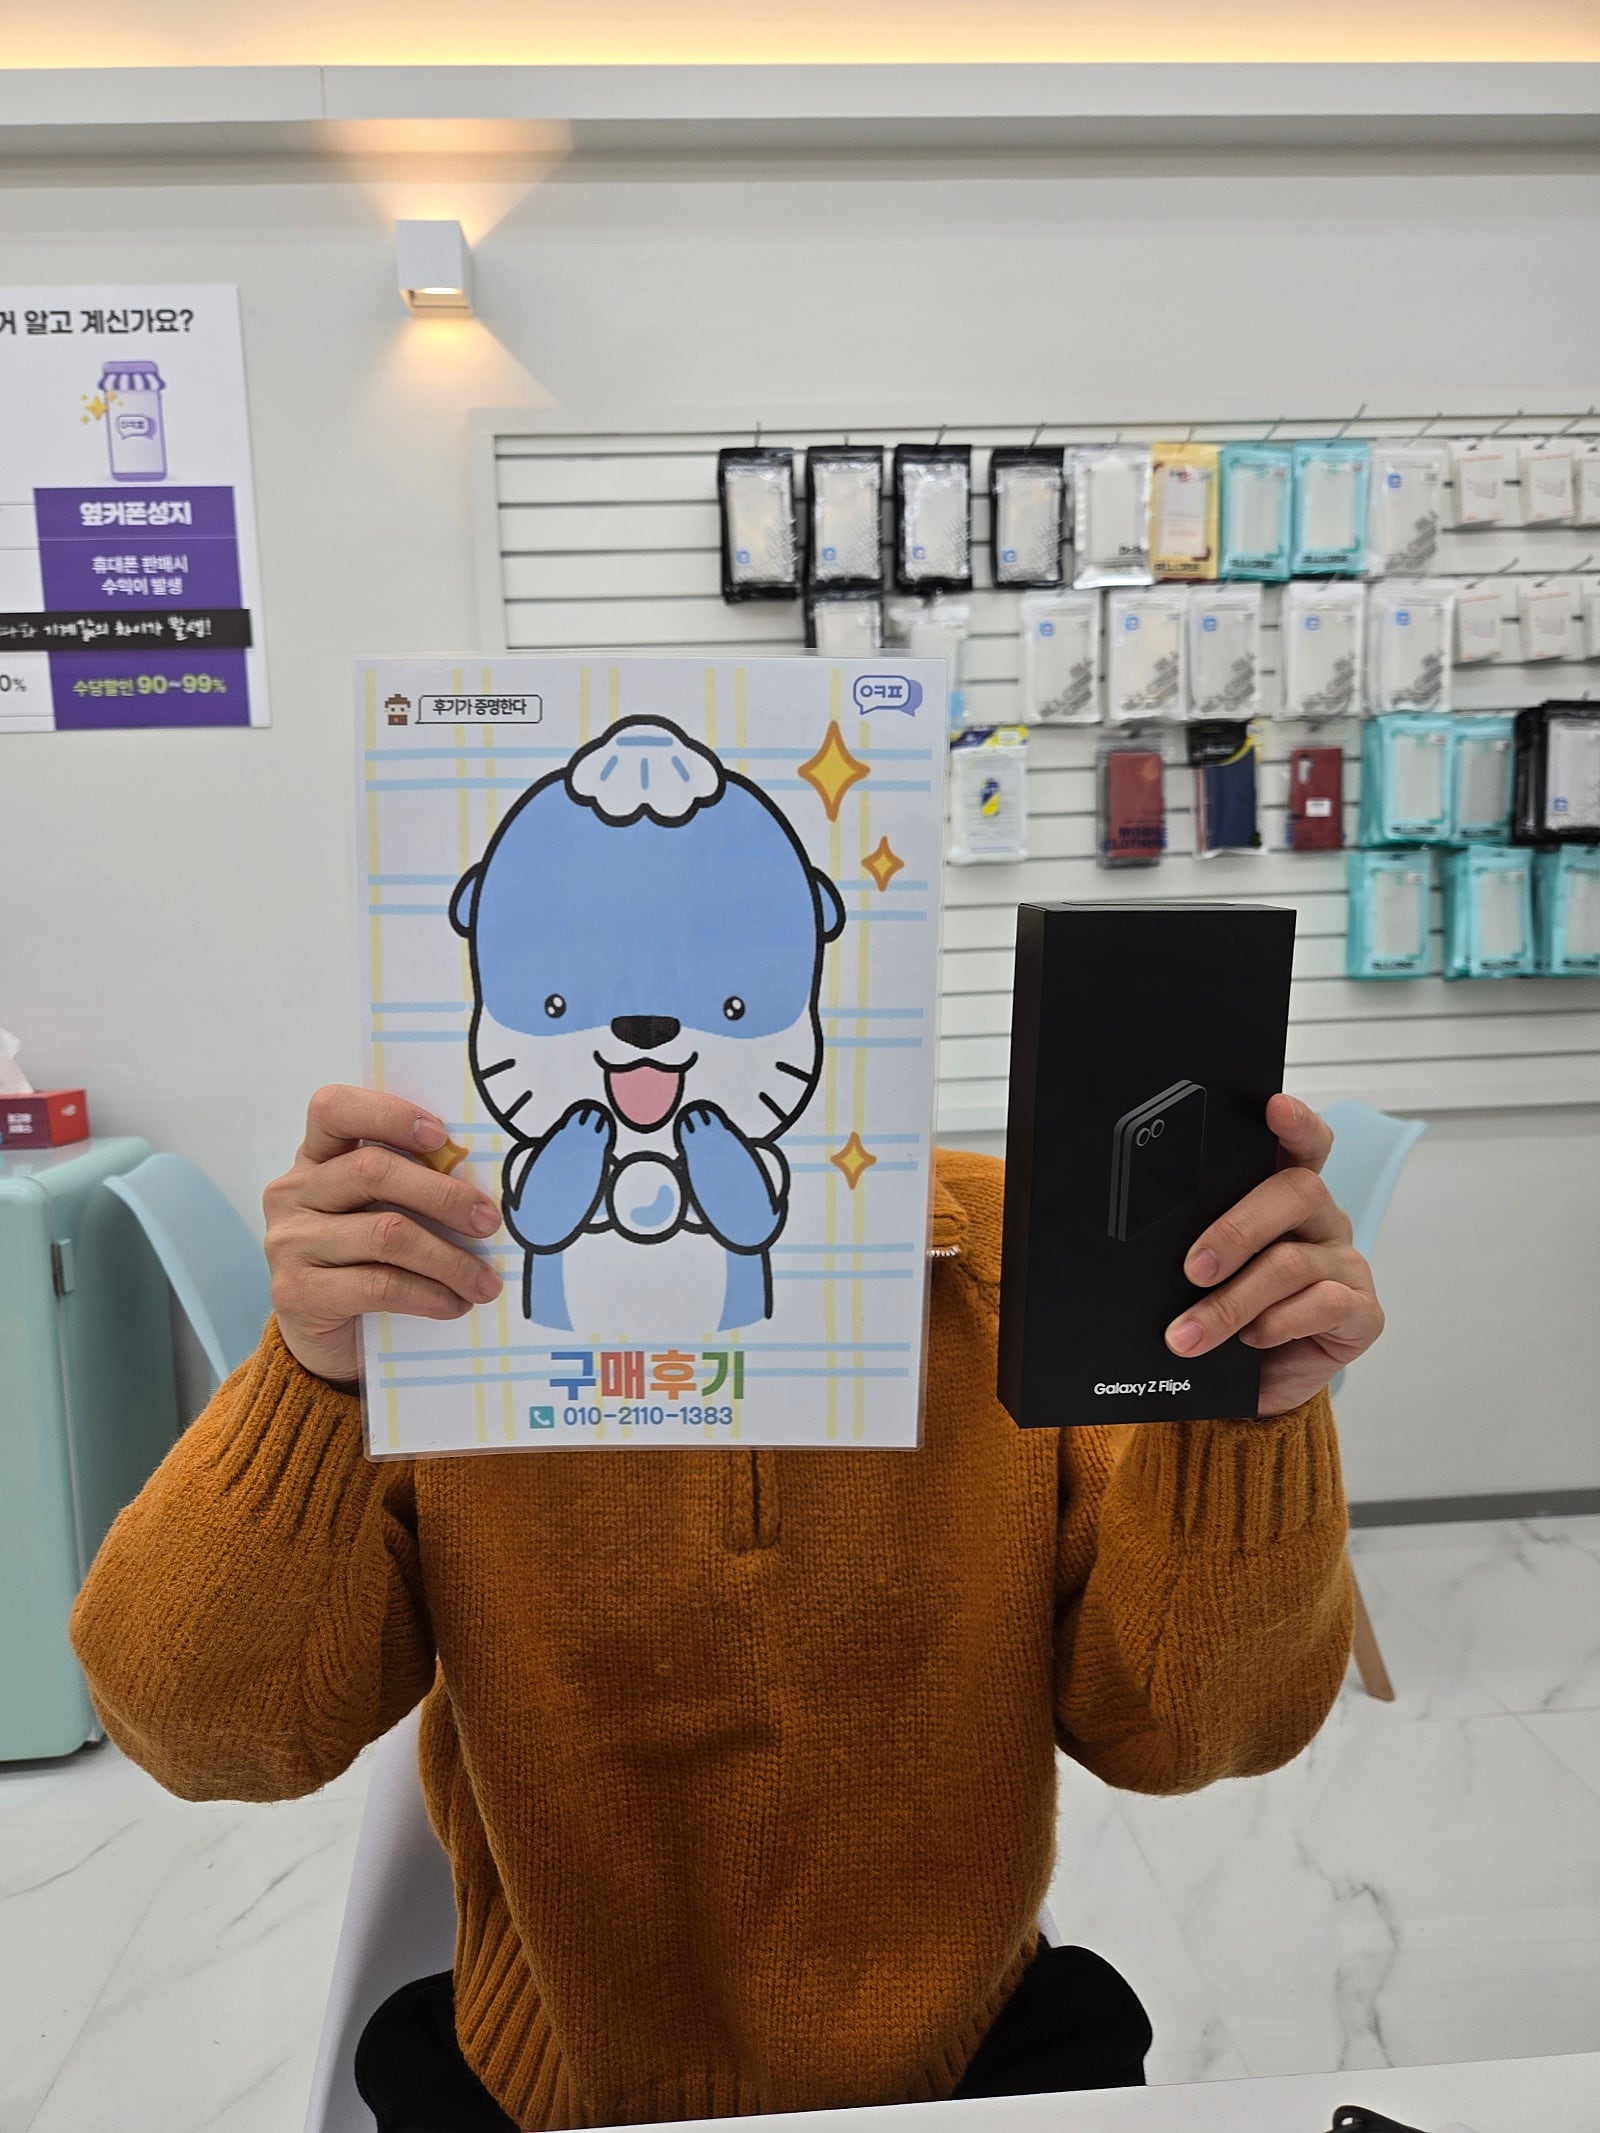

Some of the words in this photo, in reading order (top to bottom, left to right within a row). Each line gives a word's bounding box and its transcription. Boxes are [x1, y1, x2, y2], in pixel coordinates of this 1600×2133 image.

[24, 310, 73, 335] 알고
[81, 308, 194, 335] 계신가요?
[79, 500, 193, 527] 옆커폰성지
[91, 555, 140, 574] 휴대폰
[141, 554, 188, 573] 판매시
[101, 579, 149, 597] 수익이
[150, 578, 183, 596] 발생
[136, 673, 228, 695] 90~99%
[433, 698, 473, 715] 후기가
[474, 698, 526, 715] 증명한다
[550, 1350, 744, 1400] 구매후기
[1094, 1383, 1146, 1395] Galaxy
[1147, 1381, 1157, 1393] Z
[1158, 1379, 1191, 1395] Flip6
[563, 1406, 734, 1427] 010-2110-1383
